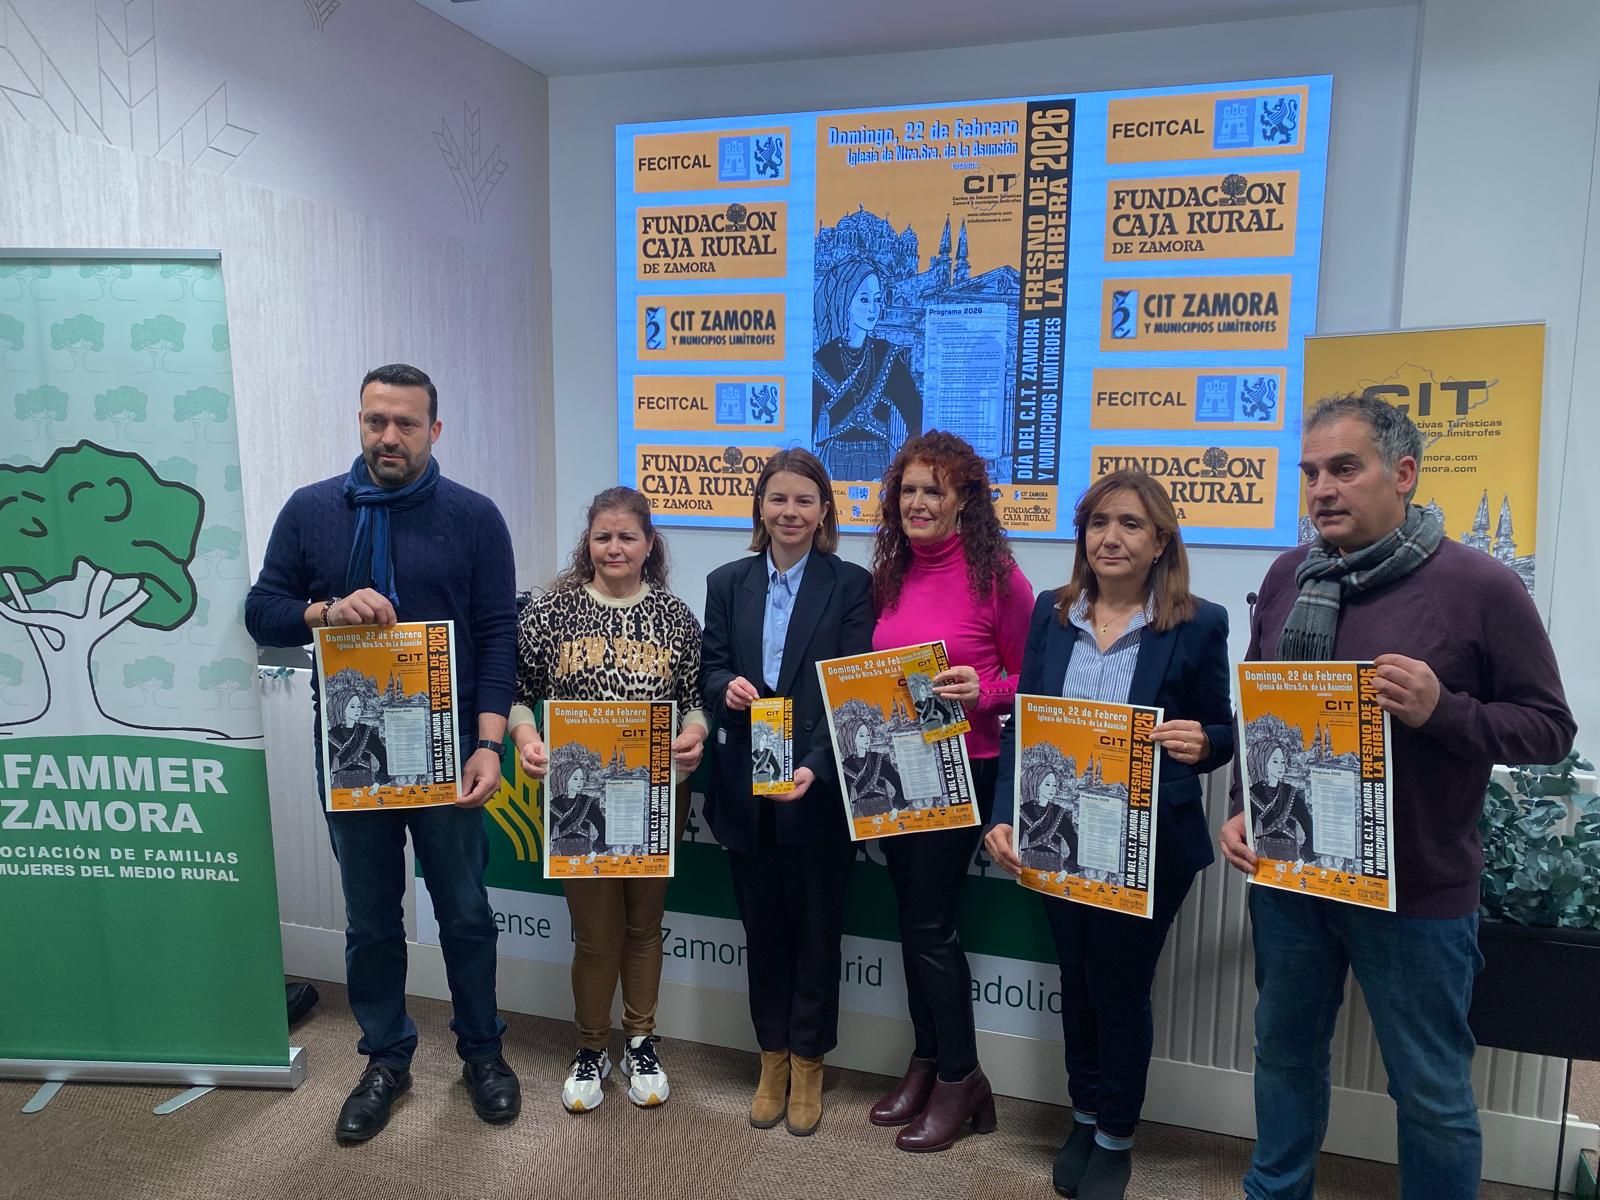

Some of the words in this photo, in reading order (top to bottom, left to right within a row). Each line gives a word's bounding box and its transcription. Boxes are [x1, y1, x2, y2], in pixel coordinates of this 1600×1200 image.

[828, 126, 899, 148] Domingo,
[904, 120, 925, 142] 22
[929, 120, 949, 141] de
[954, 117, 1019, 139] Febrero
[1030, 108, 1069, 171] 2026
[1112, 119, 1204, 139] FECITCAL
[638, 154, 711, 171] FECITCAL
[847, 147, 879, 168] Iglesia
[881, 146, 893, 163] de
[943, 142, 956, 159] de
[958, 142, 970, 158] La
[971, 139, 1018, 157] Asunción
[964, 174, 1016, 193] CIT
[1029, 176, 1048, 206] DE
[1046, 177, 1068, 270] RIBERA
[1113, 212, 1178, 238] CAJA
[1187, 208, 1283, 235] RURAL
[642, 237, 694, 260] CAJA
[702, 236, 777, 257] RURAL
[1112, 242, 1133, 254] DE
[1139, 240, 1205, 253] ZAMORA
[643, 263, 660, 274] DE
[664, 262, 716, 273] ZAMORA
[1024, 214, 1047, 311] FRESNO
[1045, 277, 1064, 308] LA
[1144, 294, 1176, 317] CIT
[1183, 292, 1279, 317] ZAMORA
[671, 311, 693, 332] CIT
[701, 310, 776, 331] ZAMORA
[1144, 324, 1150, 334] Y
[1154, 321, 1214, 333] MUNICIPIOS
[1217, 318, 1276, 332] LIMÍTROFES
[672, 336, 677, 345] Y
[679, 335, 726, 345] MUNICIPIOS
[729, 332, 775, 345] LIMÍTROFES
[1022, 318, 1040, 382] ZAMORA
[1040, 317, 1061, 390] LIMÍTROFES
[637, 396, 708, 411] FECITCAL
[1020, 386, 1037, 421] C.I.T.
[1097, 392, 1187, 406] FECITCAL
[1019, 425, 1034, 449] DEL
[1038, 394, 1057, 465] MUNICIPIOS
[1015, 455, 1034, 479] DÍA
[1038, 471, 1053, 480] Y
[642, 475, 696, 496] CAJA
[700, 477, 753, 497] RURA
[1170, 481, 1263, 504] RURAL
[663, 499, 713, 510] ZAMORA
[391, 631, 422, 639] Febrero
[428, 626, 447, 652] 2026
[397, 653, 423, 662] CIT
[430, 654, 439, 669] DE
[828, 664, 863, 676] Domingo,
[864, 661, 874, 669] 22
[876, 659, 886, 667] de
[440, 654, 450, 692] RIBERA
[1245, 671, 1285, 682] Domingo,
[1288, 671, 1299, 680] 22
[1303, 671, 1313, 681] de
[1316, 671, 1352, 681] Febrero
[431, 670, 441, 711] FRESNO
[441, 695, 451, 709] LA
[555, 708, 590, 717] Domingo,
[1027, 703, 1065, 716] Domingo,
[1068, 706, 1079, 716] 22
[1082, 708, 1092, 716] de
[1095, 709, 1127, 721] Febrero
[1325, 700, 1354, 711] CIT
[1361, 704, 1372, 720] DE
[653, 706, 670, 729] 2026
[1134, 712, 1155, 742] 2026
[653, 730, 660, 742] DE
[1100, 736, 1127, 747] CIT
[1372, 706, 1383, 757] RIBERA
[661, 732, 670, 767] RIBERA
[1133, 742, 1144, 759] DE
[1362, 724, 1373, 778] FRESNO
[0, 754, 228, 794] FAMMER
[652, 745, 660, 784] FRESNO
[1141, 745, 1153, 789] RIBERA
[1374, 762, 1384, 778] LA
[661, 771, 669, 782] LA
[1130, 761, 1142, 807] FRESNO
[1140, 791, 1150, 807] LA
[1363, 782, 1373, 817] ZAMORA
[1373, 783, 1384, 824] LIMÍTROFES
[1, 799, 203, 833] ZAMORA
[1129, 810, 1139, 840] ZAMORA
[1364, 820, 1373, 840] C.I.T.
[0, 845, 100, 860] OCIACIÓN
[110, 848, 135, 861] DE
[144, 849, 239, 864] FAMILIAS
[1128, 842, 1137, 858] C.I.T.
[1364, 843, 1373, 857] DEL
[1376, 826, 1385, 870] MUNICIPIOS
[81, 865, 114, 878] DEL
[120, 866, 176, 880] MEDIO
[181, 868, 239, 882] RURAL
[1128, 860, 1136, 873] DEL
[1138, 847, 1147, 884] MUNICIPIOS
[1363, 859, 1374, 874] DÍA
[1126, 874, 1135, 886] DÍA
[492, 911, 551, 939] ense
[661, 927, 748, 966] Zamor
[845, 955, 882, 986] rid
